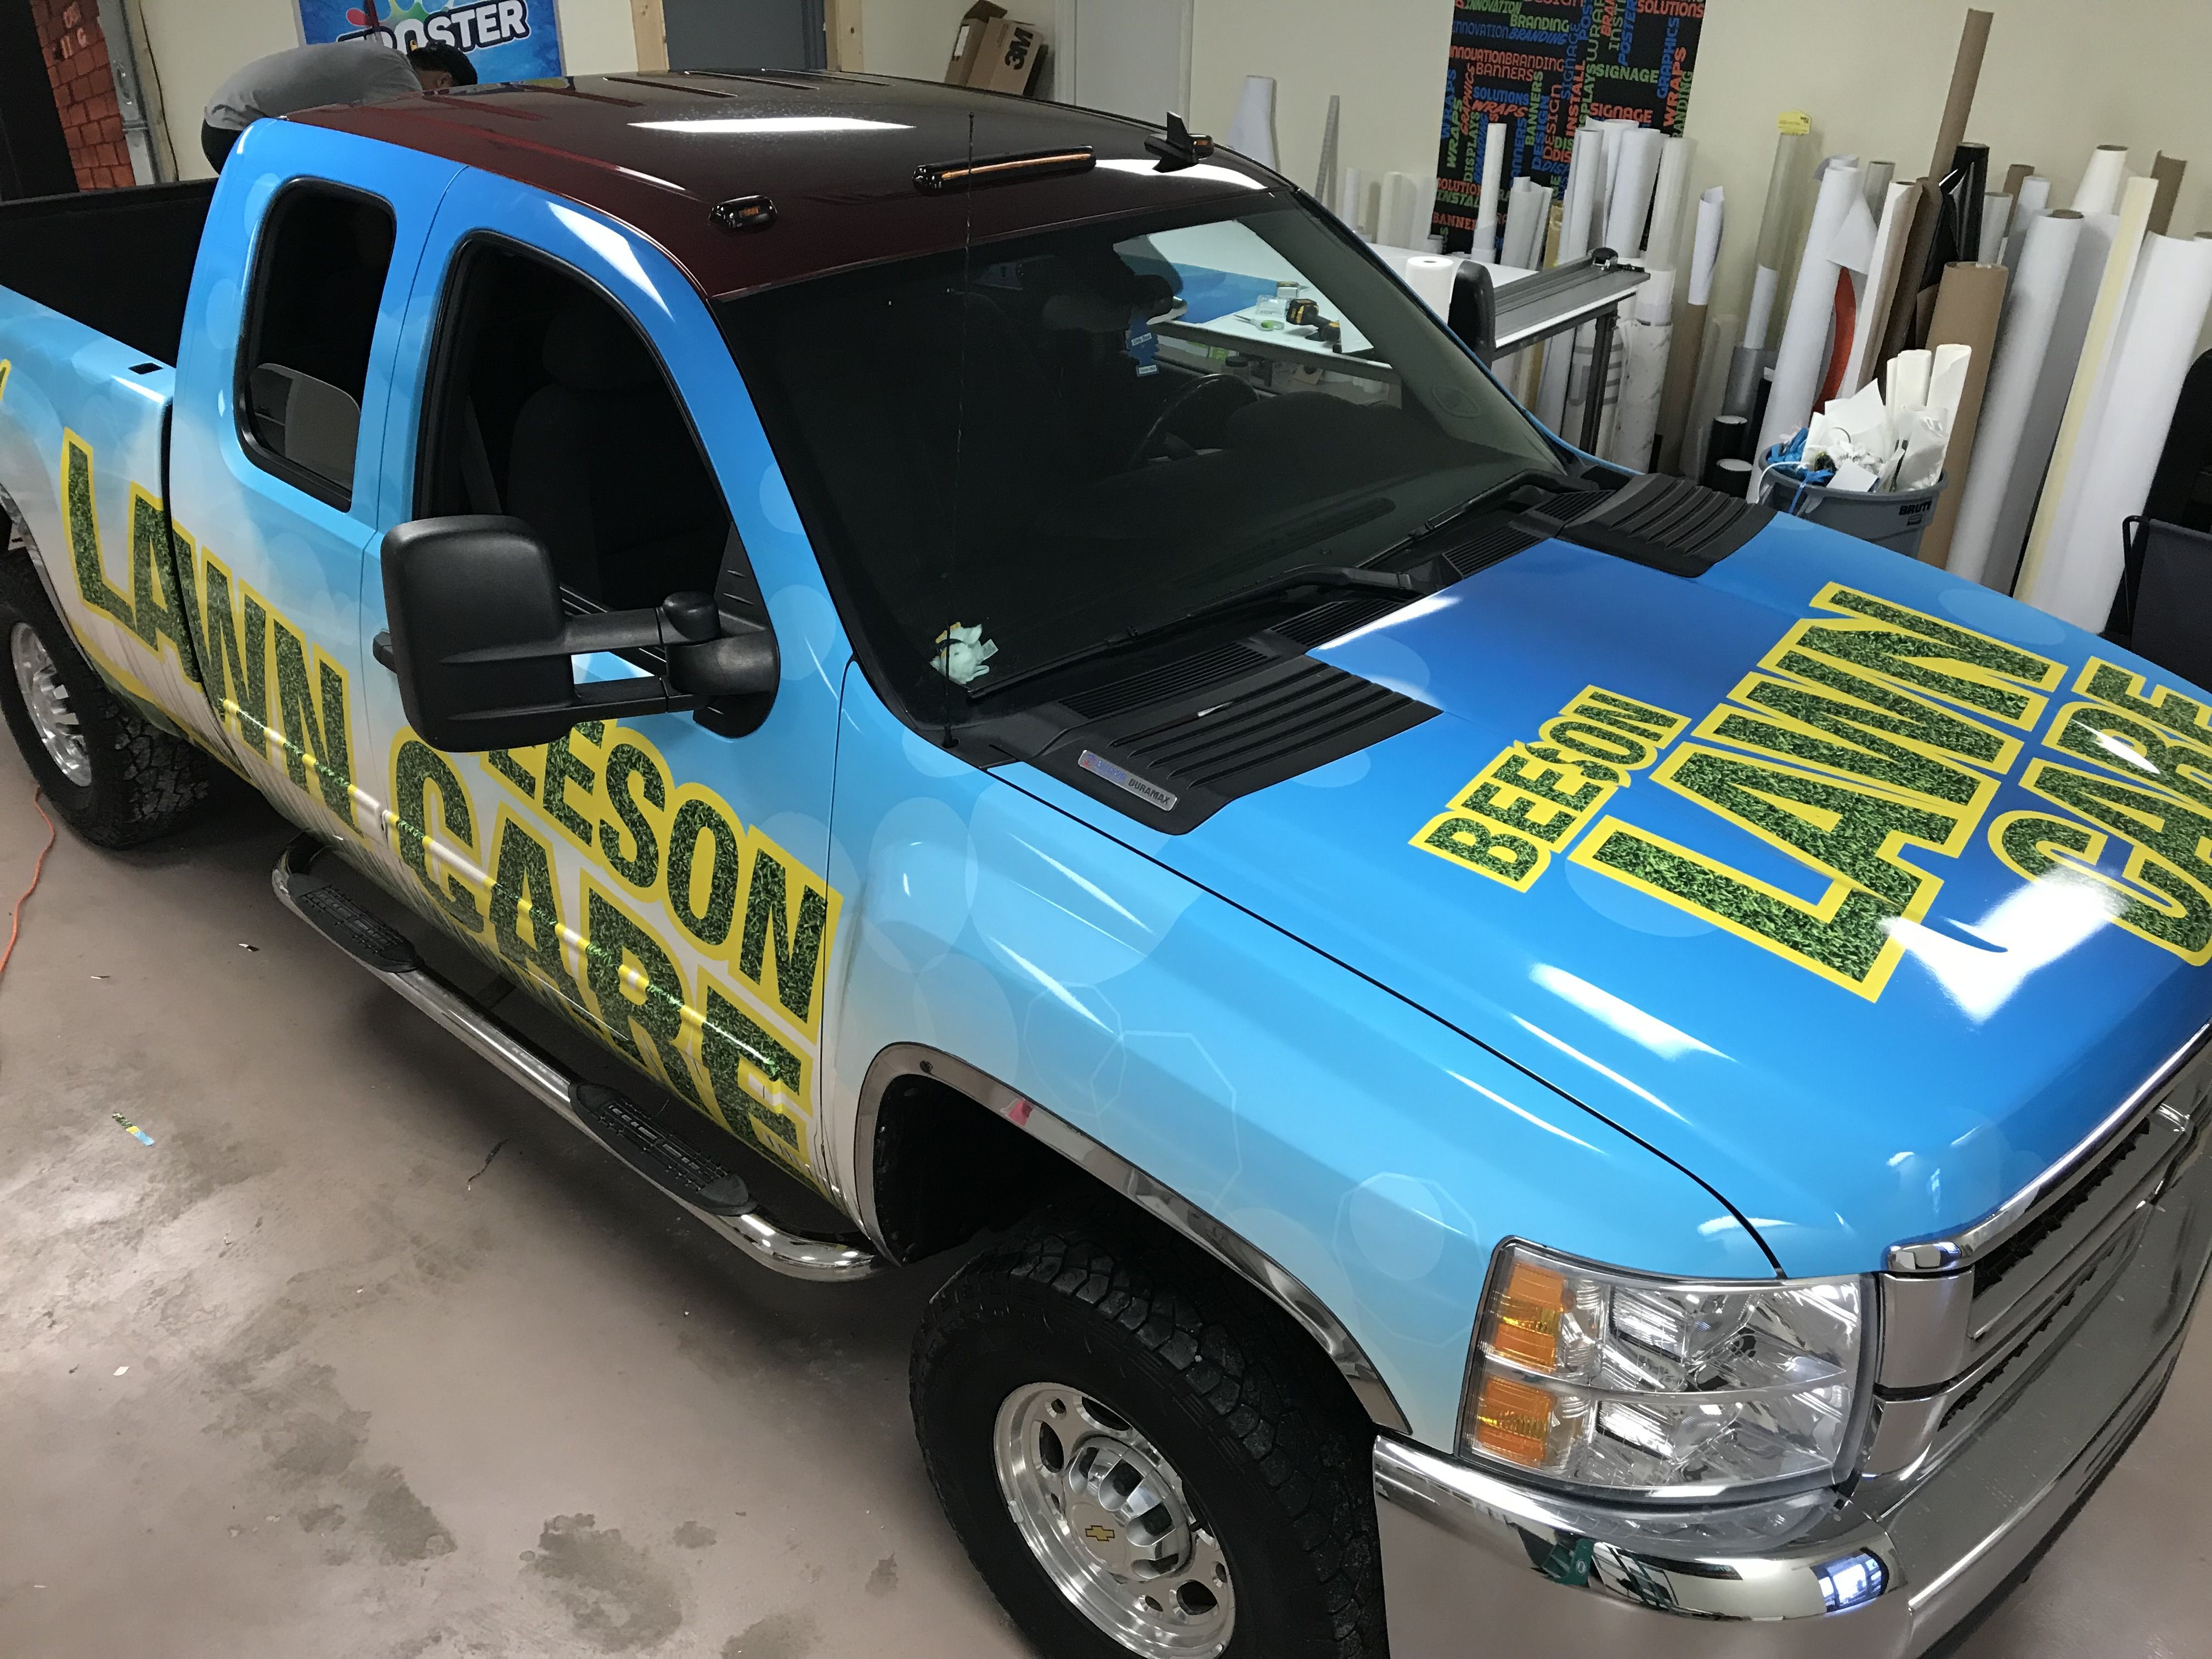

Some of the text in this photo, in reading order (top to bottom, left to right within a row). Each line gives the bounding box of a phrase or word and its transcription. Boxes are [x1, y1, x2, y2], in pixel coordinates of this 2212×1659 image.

[339, 1, 527, 54] OSTER
[1005, 27, 1034, 70] 3M
[1525, 70, 1543, 145] BANNERS
[1663, 47, 1687, 127] WRAPS
[1673, 70, 1694, 137] RANDING
[1510, 117, 1528, 188] ANNERS
[67, 438, 366, 840] LAWN
[1127, 778, 1171, 806] DURAMAX
[1421, 689, 1681, 884] BEESON
[1591, 586, 2054, 985] LAWN
[2001, 662, 2212, 955] CARE
[486, 719, 828, 1026] ESON
[394, 737, 817, 1192] CARE
